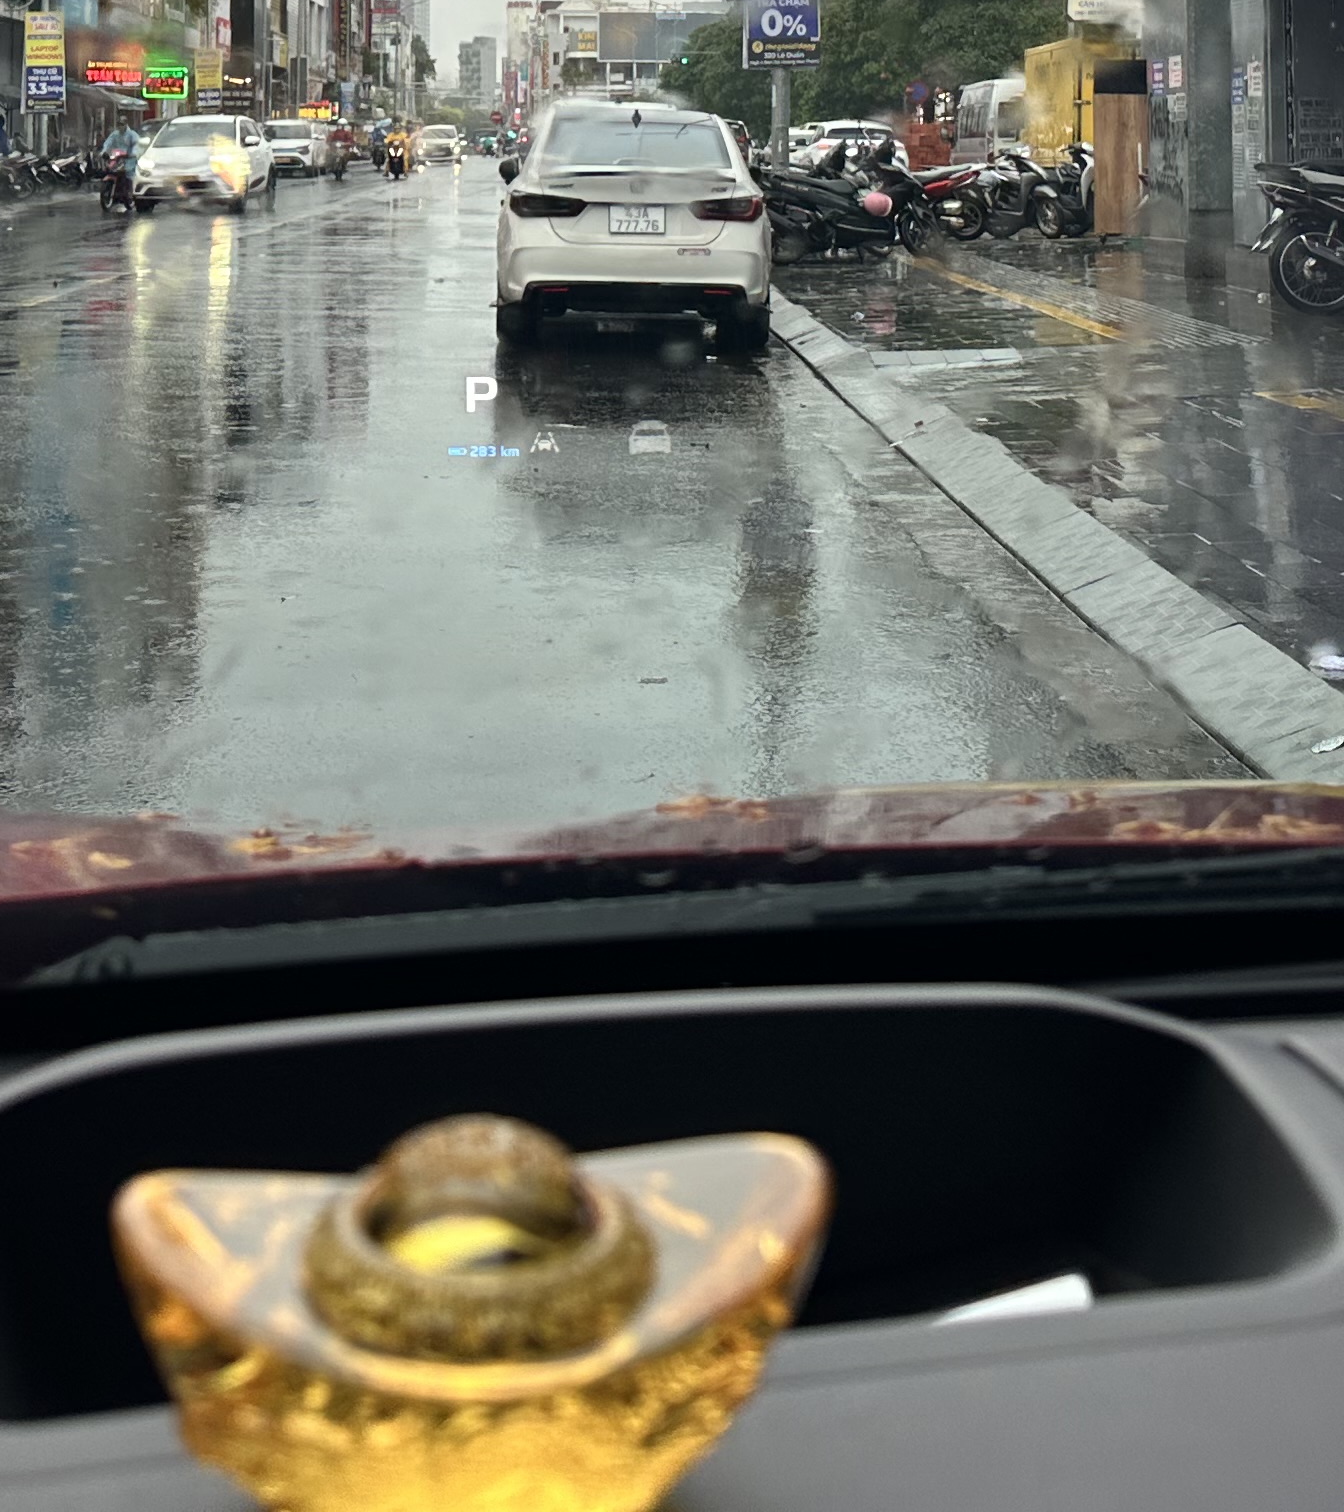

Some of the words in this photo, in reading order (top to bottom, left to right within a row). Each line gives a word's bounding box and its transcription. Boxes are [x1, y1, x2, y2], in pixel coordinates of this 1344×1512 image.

[760, 8, 807, 37] 0%
[615, 219, 660, 232] 777.76
[465, 376, 499, 413] P
[469, 446, 497, 457] 283
[500, 445, 520, 457] km
